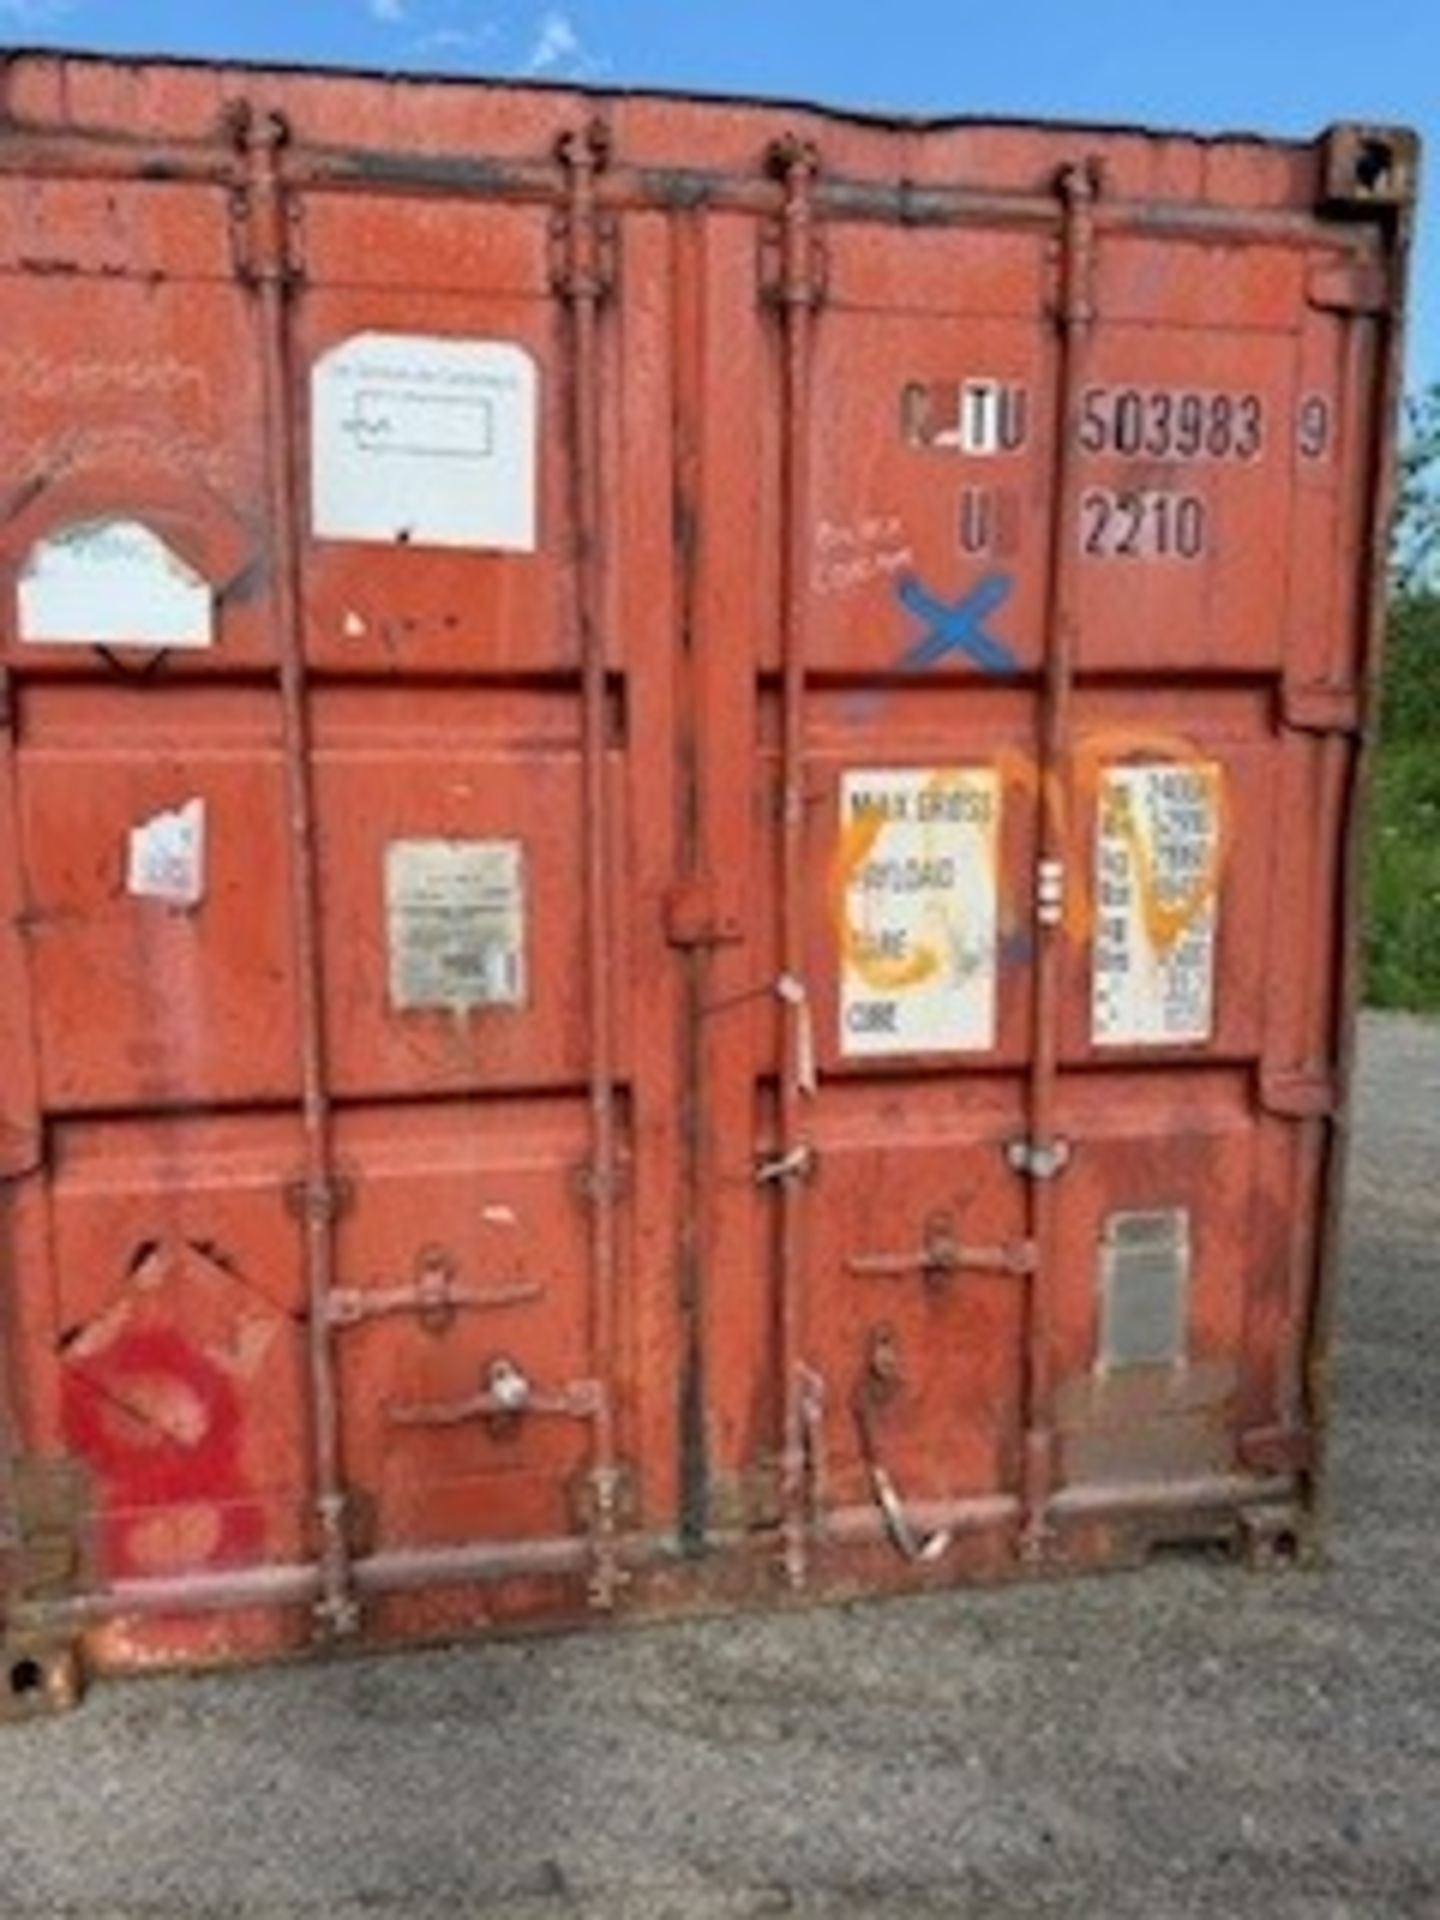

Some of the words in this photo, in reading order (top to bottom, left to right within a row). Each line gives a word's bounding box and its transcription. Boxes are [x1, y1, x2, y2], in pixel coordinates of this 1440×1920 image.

[901, 380, 1027, 452] CTU
[1079, 389, 1263, 458] 503983
[1300, 395, 1328, 458] 9
[1084, 491, 1203, 558] 2210
